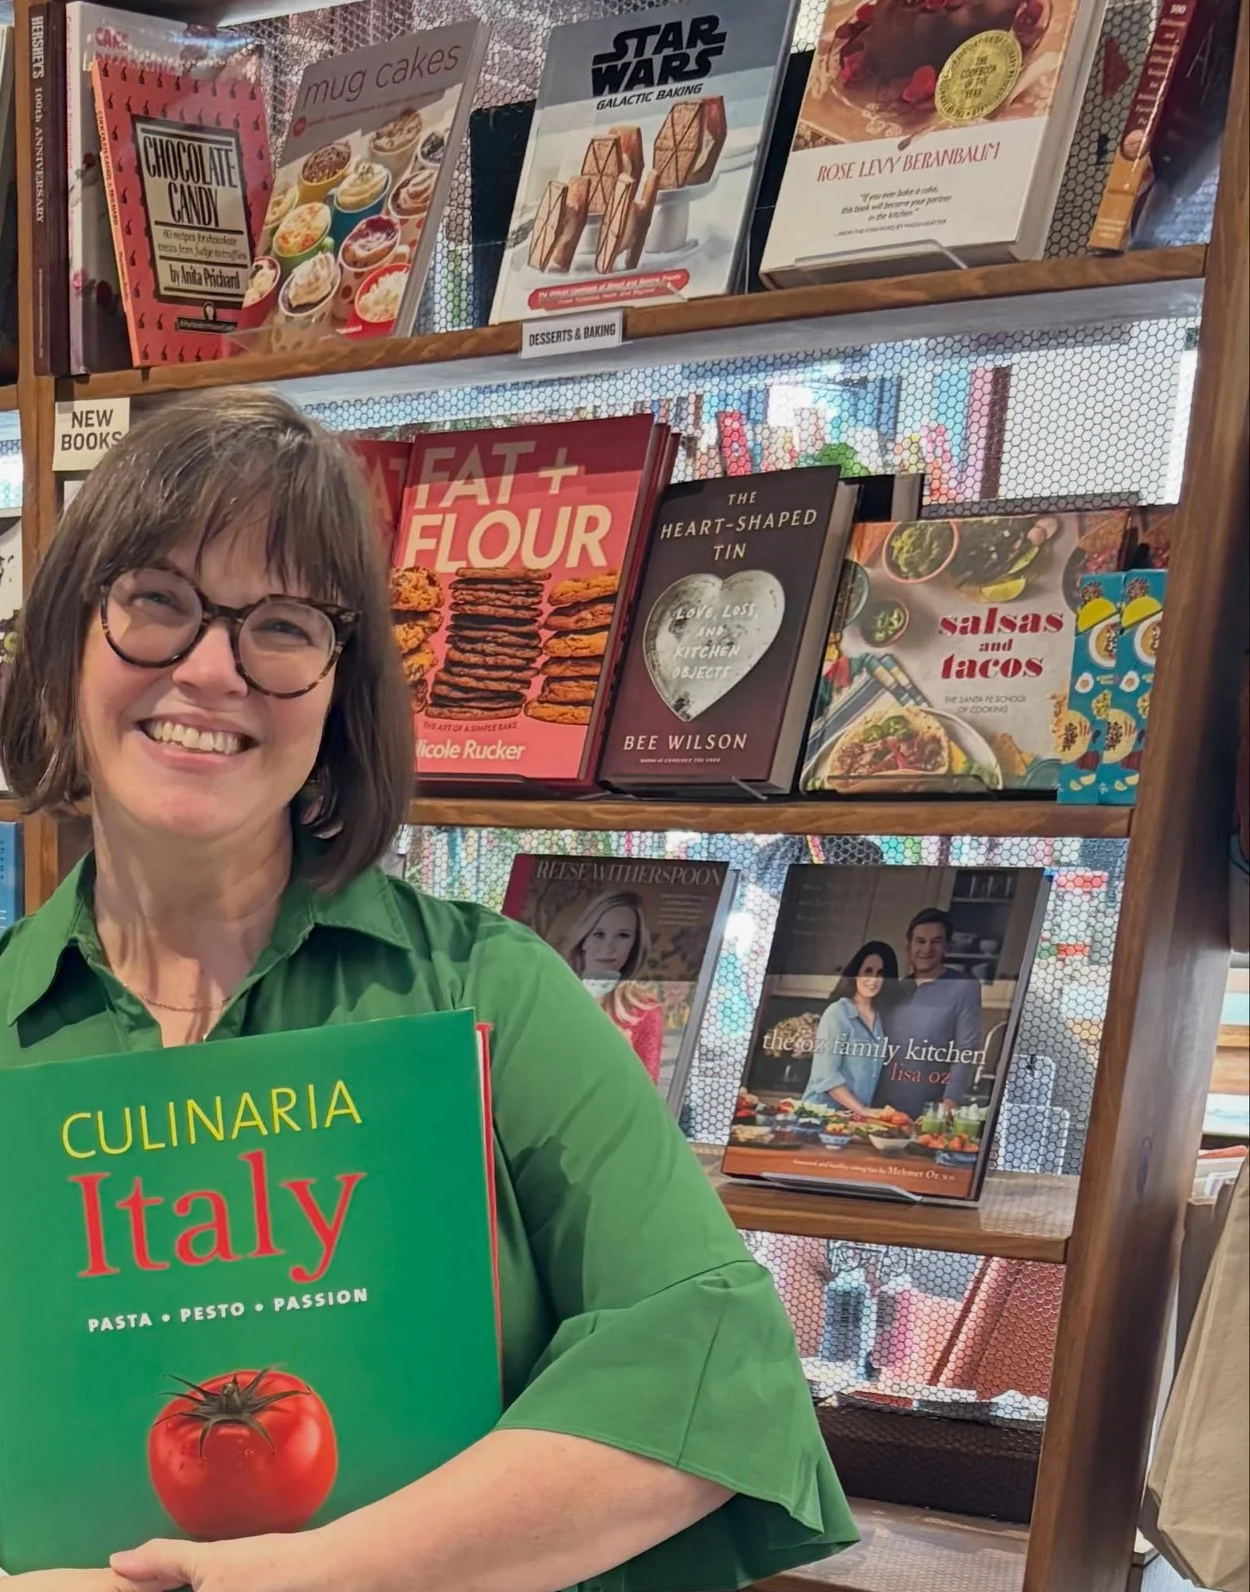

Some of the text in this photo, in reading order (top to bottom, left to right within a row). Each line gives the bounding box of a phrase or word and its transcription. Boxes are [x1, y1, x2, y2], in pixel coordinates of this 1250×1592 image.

[595, 14, 729, 66] STAR
[302, 40, 461, 110] mug cakes
[591, 44, 724, 98] WARS
[596, 83, 703, 112] GALACTIC BAKING
[142, 135, 239, 189] CHOCOLATE
[817, 141, 1000, 183] ROSE LEVY BERANBAUM
[167, 182, 221, 228] CANDY
[169, 264, 241, 290] by Anita Prichard
[529, 323, 617, 348] DESSERTS & BAKING
[71, 409, 114, 429] NEW
[414, 440, 537, 509] FAT
[538, 447, 585, 495] +
[727, 491, 757, 506] THE
[403, 504, 612, 569] FLOUR
[659, 508, 818, 541] HEART-SHAPED
[713, 543, 746, 561] TIN
[696, 625, 724, 639] AND
[938, 607, 1064, 636] salsas
[673, 644, 740, 660] KITCHEN
[978, 638, 1014, 653] and
[671, 665, 730, 682] OBJECTS
[941, 653, 1044, 680] tacos
[623, 732, 748, 752] BEE WILSON
[536, 861, 722, 887] REESE WITHERSPOON
[762, 1030, 987, 1066] the oz family kitchen
[890, 1063, 951, 1085] lisa oz
[62, 1079, 363, 1159] CULINARIA
[67, 1147, 368, 1284] Italy
[88, 1287, 369, 1333] PASTA PESTO PASSION
